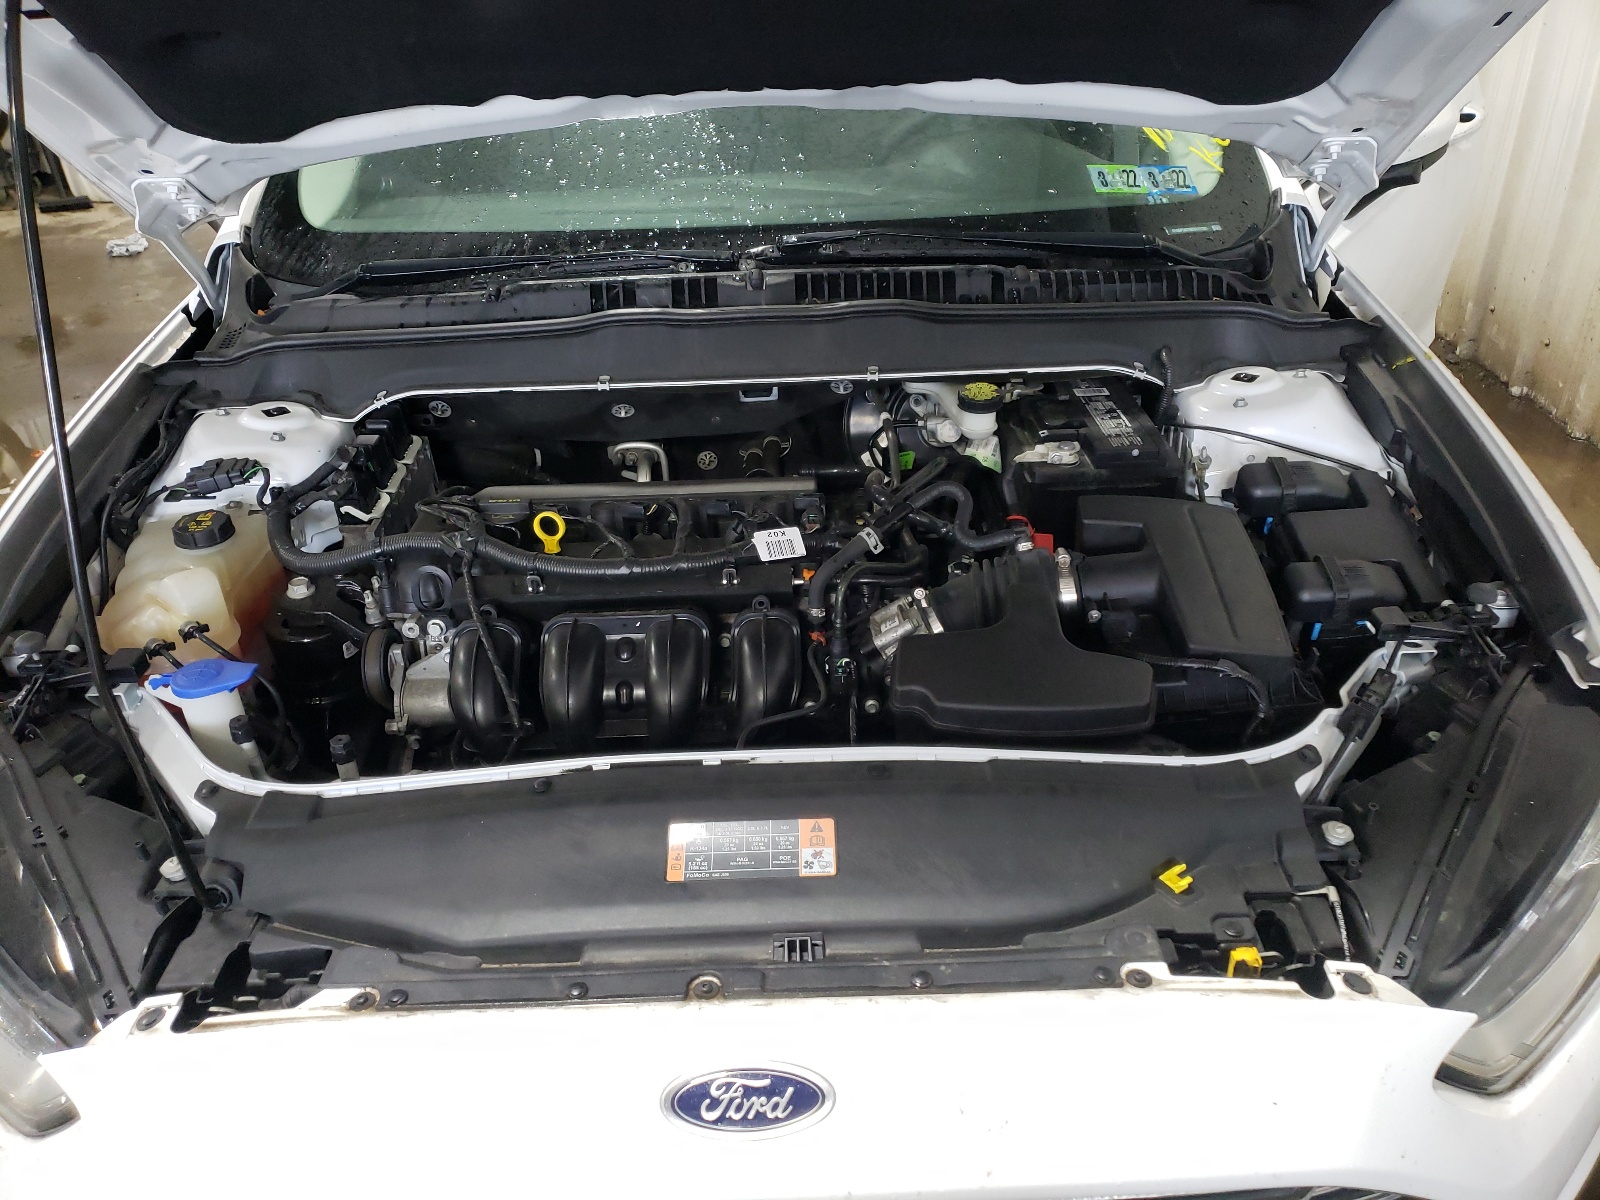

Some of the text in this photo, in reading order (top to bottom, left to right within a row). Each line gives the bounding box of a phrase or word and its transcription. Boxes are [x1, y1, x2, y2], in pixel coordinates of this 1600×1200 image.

[1121, 169, 1141, 188] 22
[1171, 169, 1191, 188] 22
[700, 1077, 795, 1122] Ford
